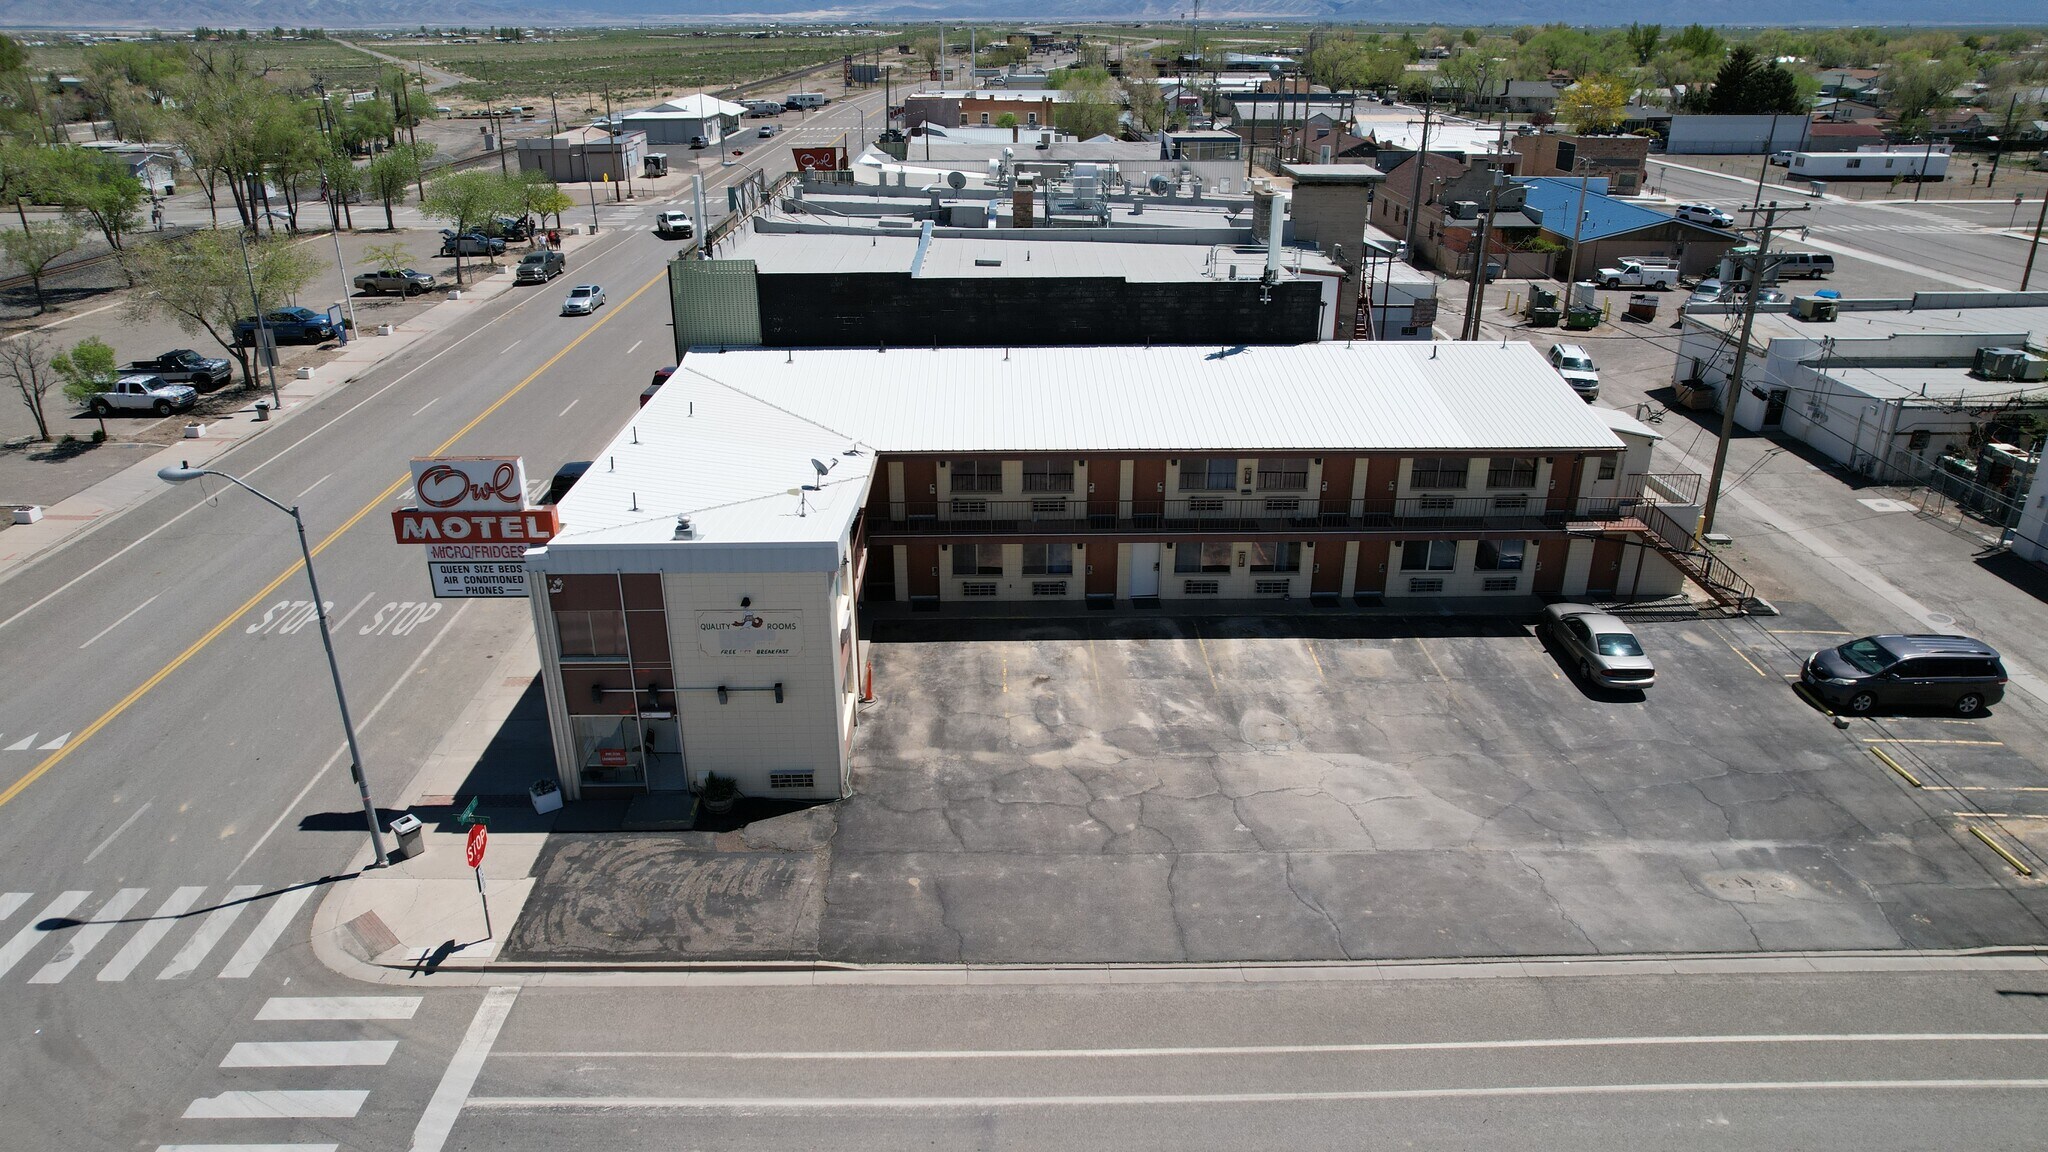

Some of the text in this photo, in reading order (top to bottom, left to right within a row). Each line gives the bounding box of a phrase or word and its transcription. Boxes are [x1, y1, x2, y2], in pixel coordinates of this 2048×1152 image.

[800, 153, 833, 167] Owl
[417, 463, 521, 508] Owl
[402, 516, 550, 540] MOTEL
[440, 565, 523, 574] QUEEN SIZE BEDS
[443, 575, 524, 585] AIR CONDITIONED
[465, 586, 504, 595] PHONES
[246, 600, 442, 635] STOP STOP
[700, 622, 797, 631] QUALITY ROOMS
[467, 828, 485, 862] STOP
